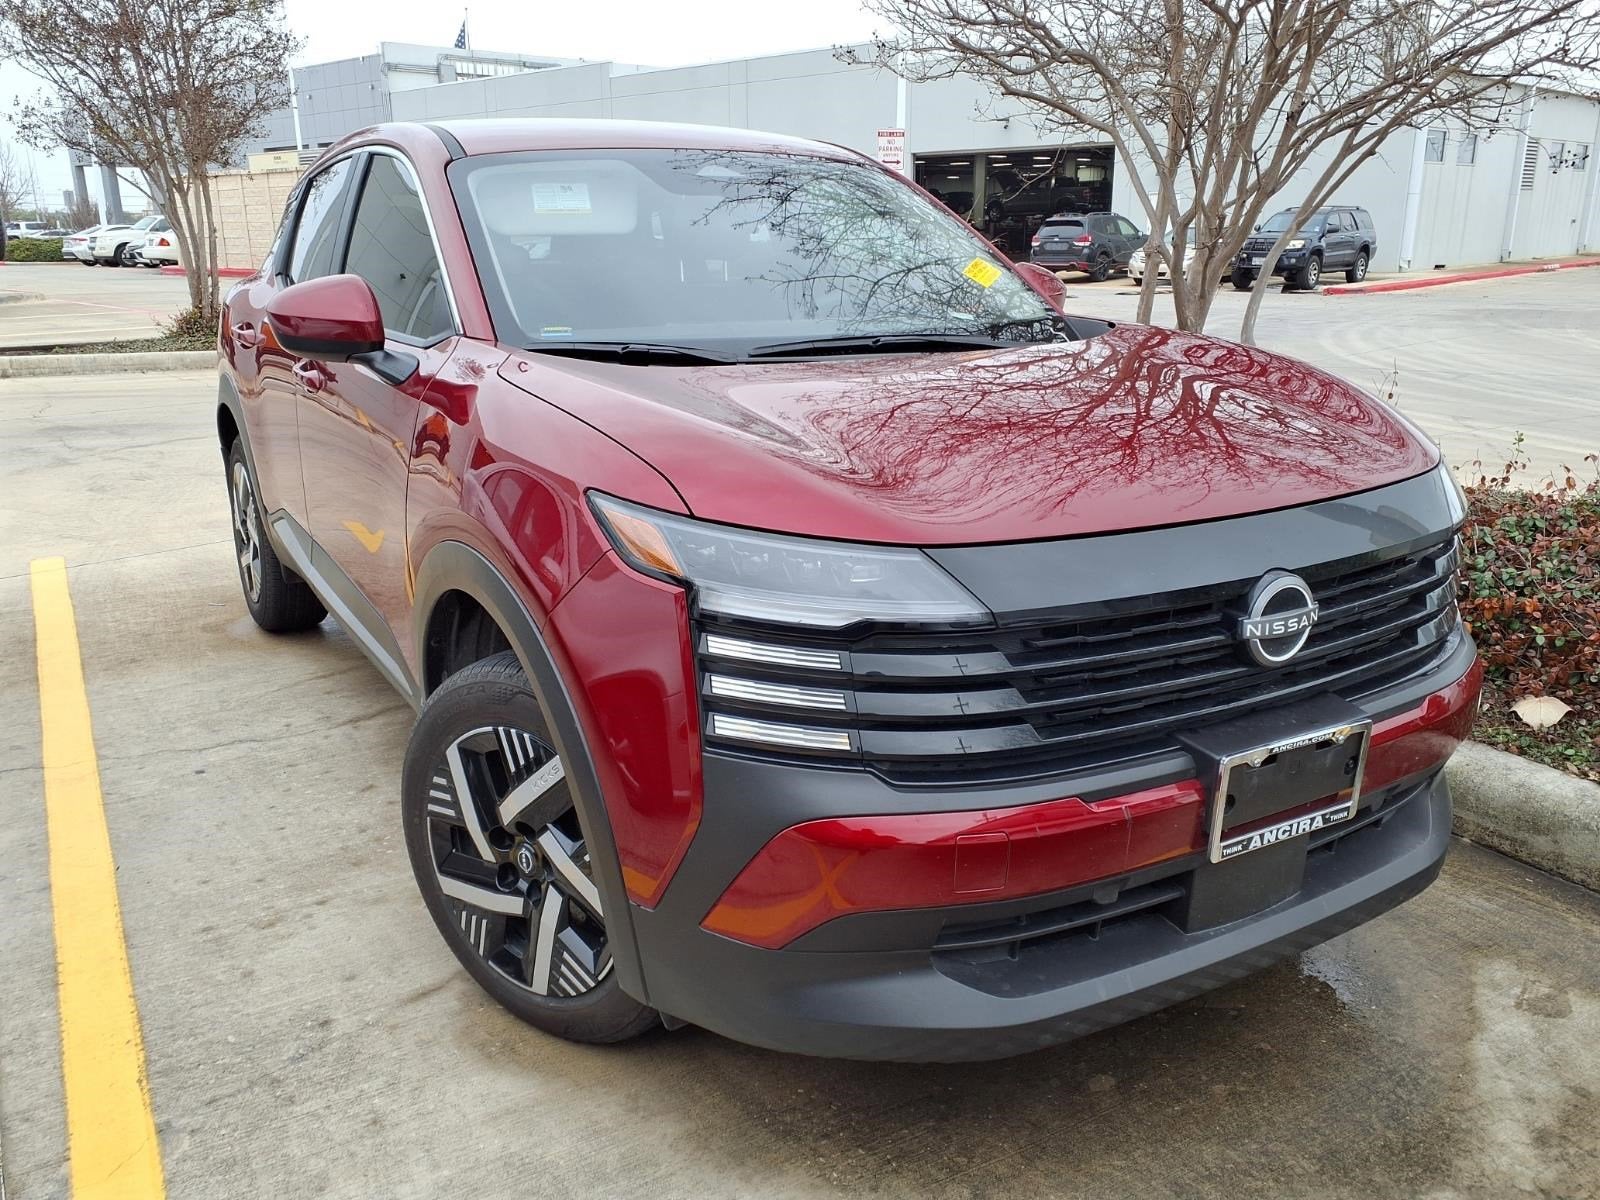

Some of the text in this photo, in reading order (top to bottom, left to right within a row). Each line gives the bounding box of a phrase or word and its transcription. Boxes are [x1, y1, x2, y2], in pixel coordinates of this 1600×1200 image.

[1246, 608, 1319, 637] NISSAN
[1272, 733, 1334, 753] ANCIRA.COM
[530, 763, 560, 793] KICKS
[1222, 810, 1349, 857] THINK ANCIRA THINK
